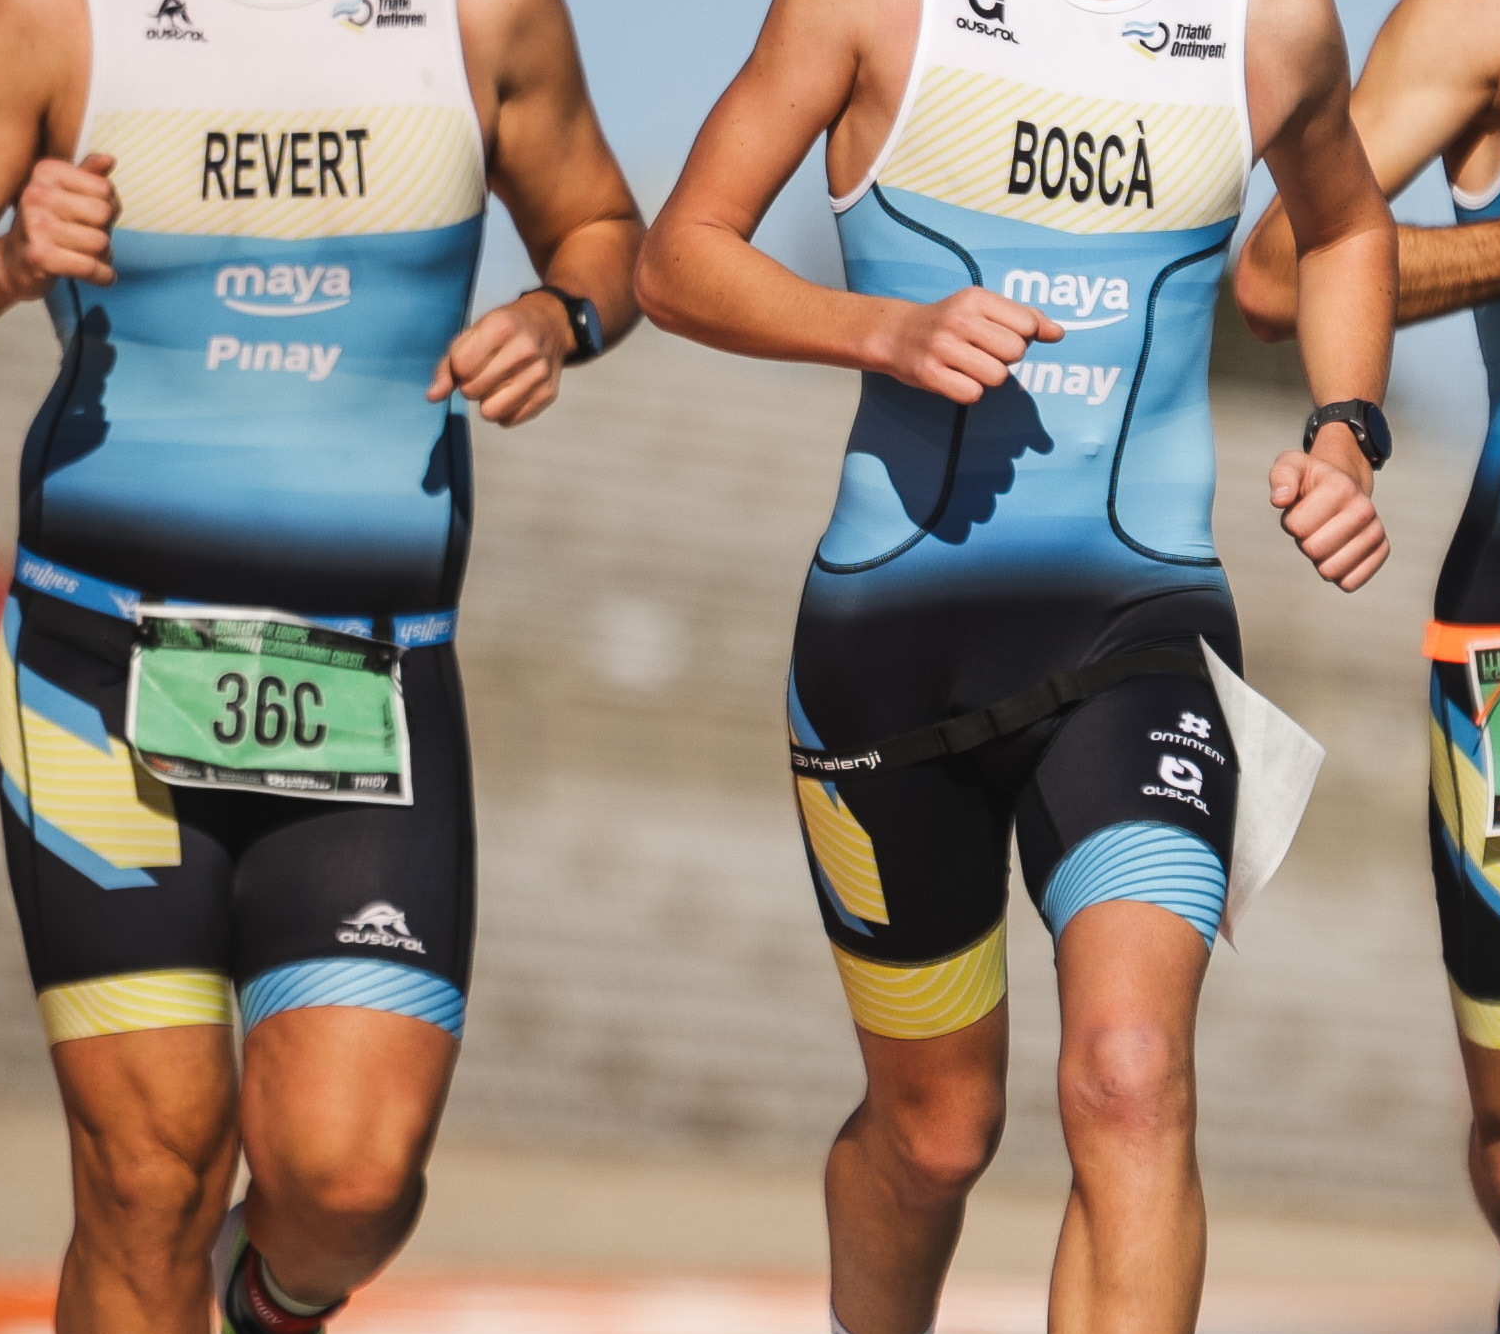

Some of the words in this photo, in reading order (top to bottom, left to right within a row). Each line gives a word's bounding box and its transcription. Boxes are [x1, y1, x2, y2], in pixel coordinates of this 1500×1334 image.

[956, 17, 1021, 45] austral
[1175, 23, 1213, 40] Triatló
[1170, 41, 1227, 59] Ontinyent
[202, 128, 370, 201] REVERT
[1008, 119, 1155, 210] BOSCÀ
[214, 264, 352, 304] maya
[1004, 269, 1130, 318] maya
[213, 672, 328, 749] 36C
[810, 751, 882, 770] Kalenji
[1142, 785, 1211, 816] austral
[336, 930, 427, 954] austral
